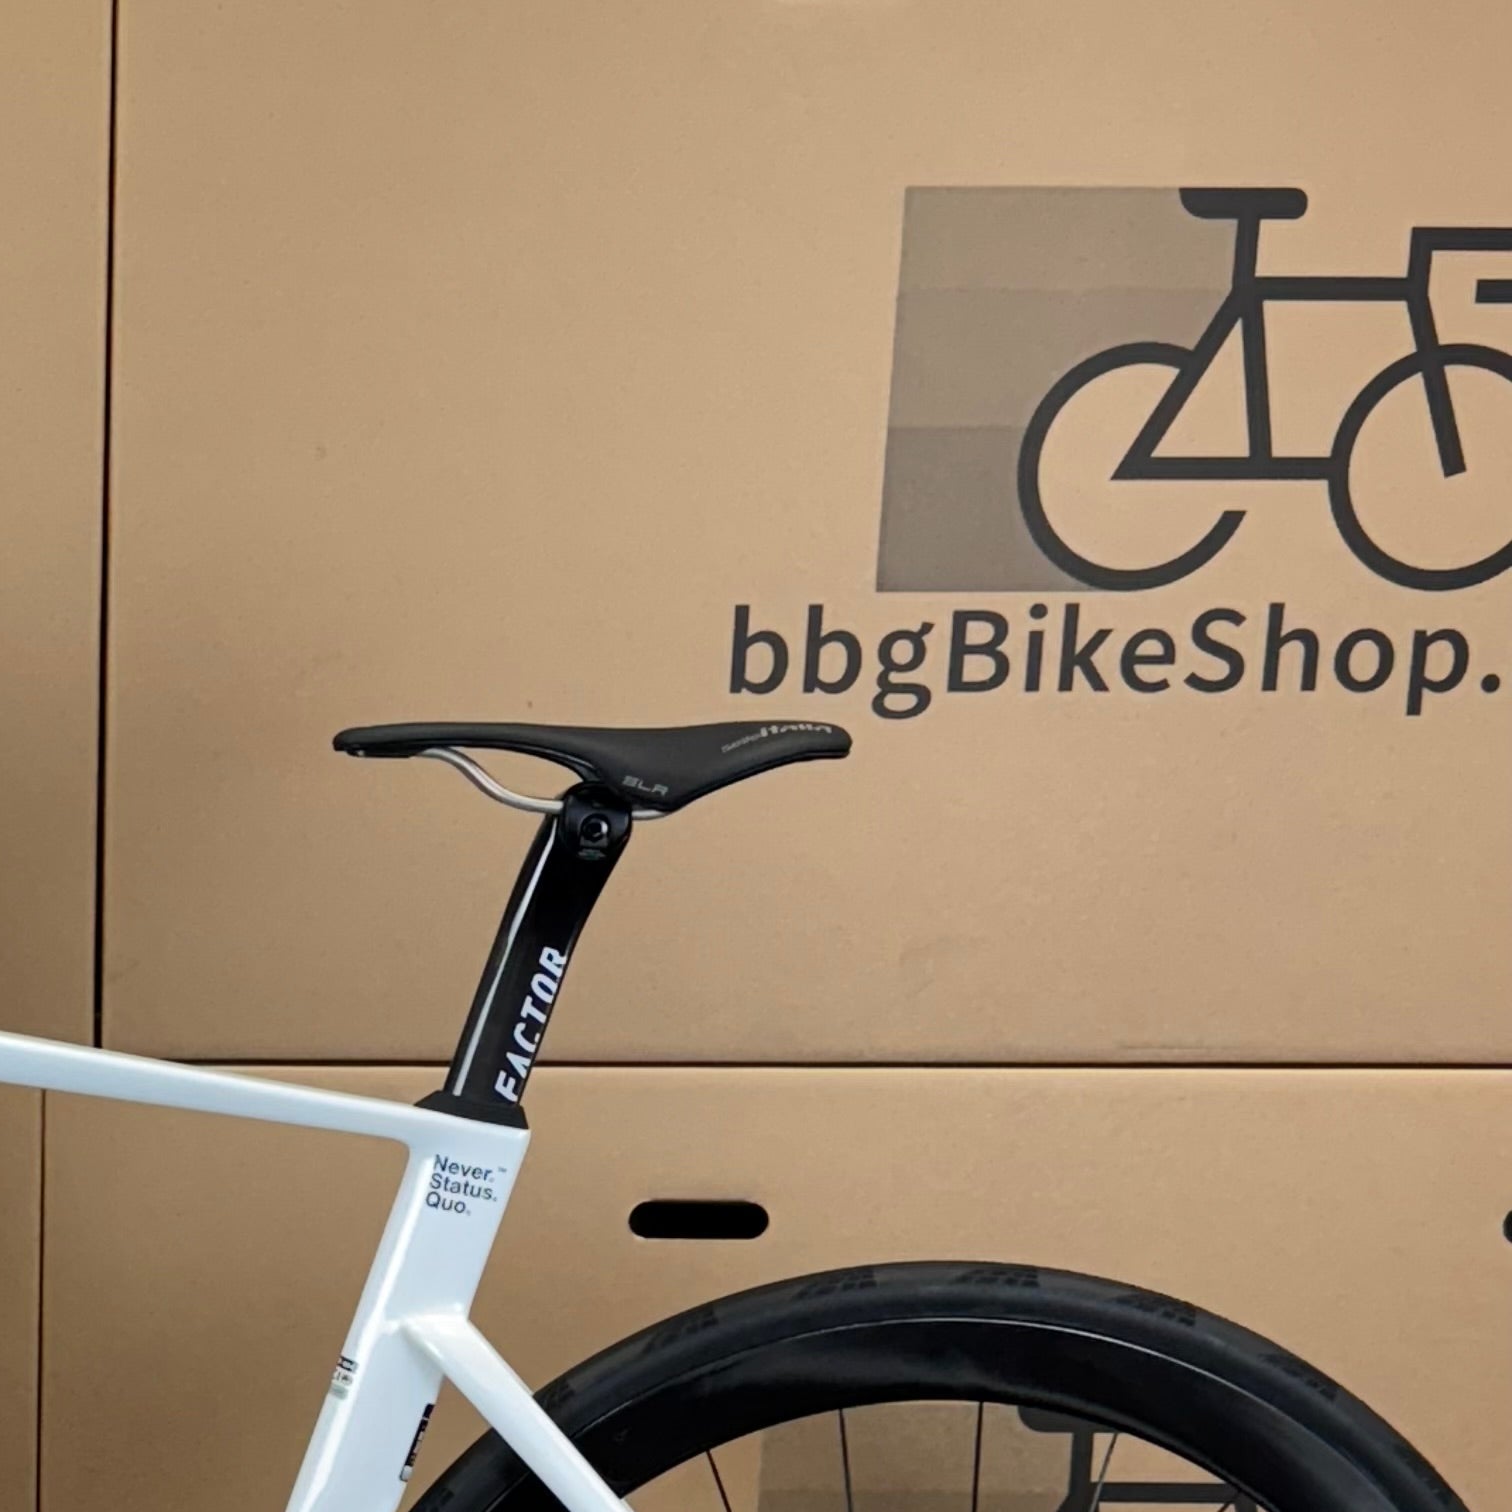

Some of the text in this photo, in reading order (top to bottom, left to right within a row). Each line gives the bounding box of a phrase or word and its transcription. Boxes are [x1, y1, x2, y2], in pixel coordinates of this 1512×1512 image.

[729, 603, 1501, 720] bbgBikeShop.
[622, 775, 669, 796] SLR
[494, 946, 568, 1103] FACTOR
[429, 1173, 498, 1202] Status.
[426, 1191, 471, 1216] Quo.
